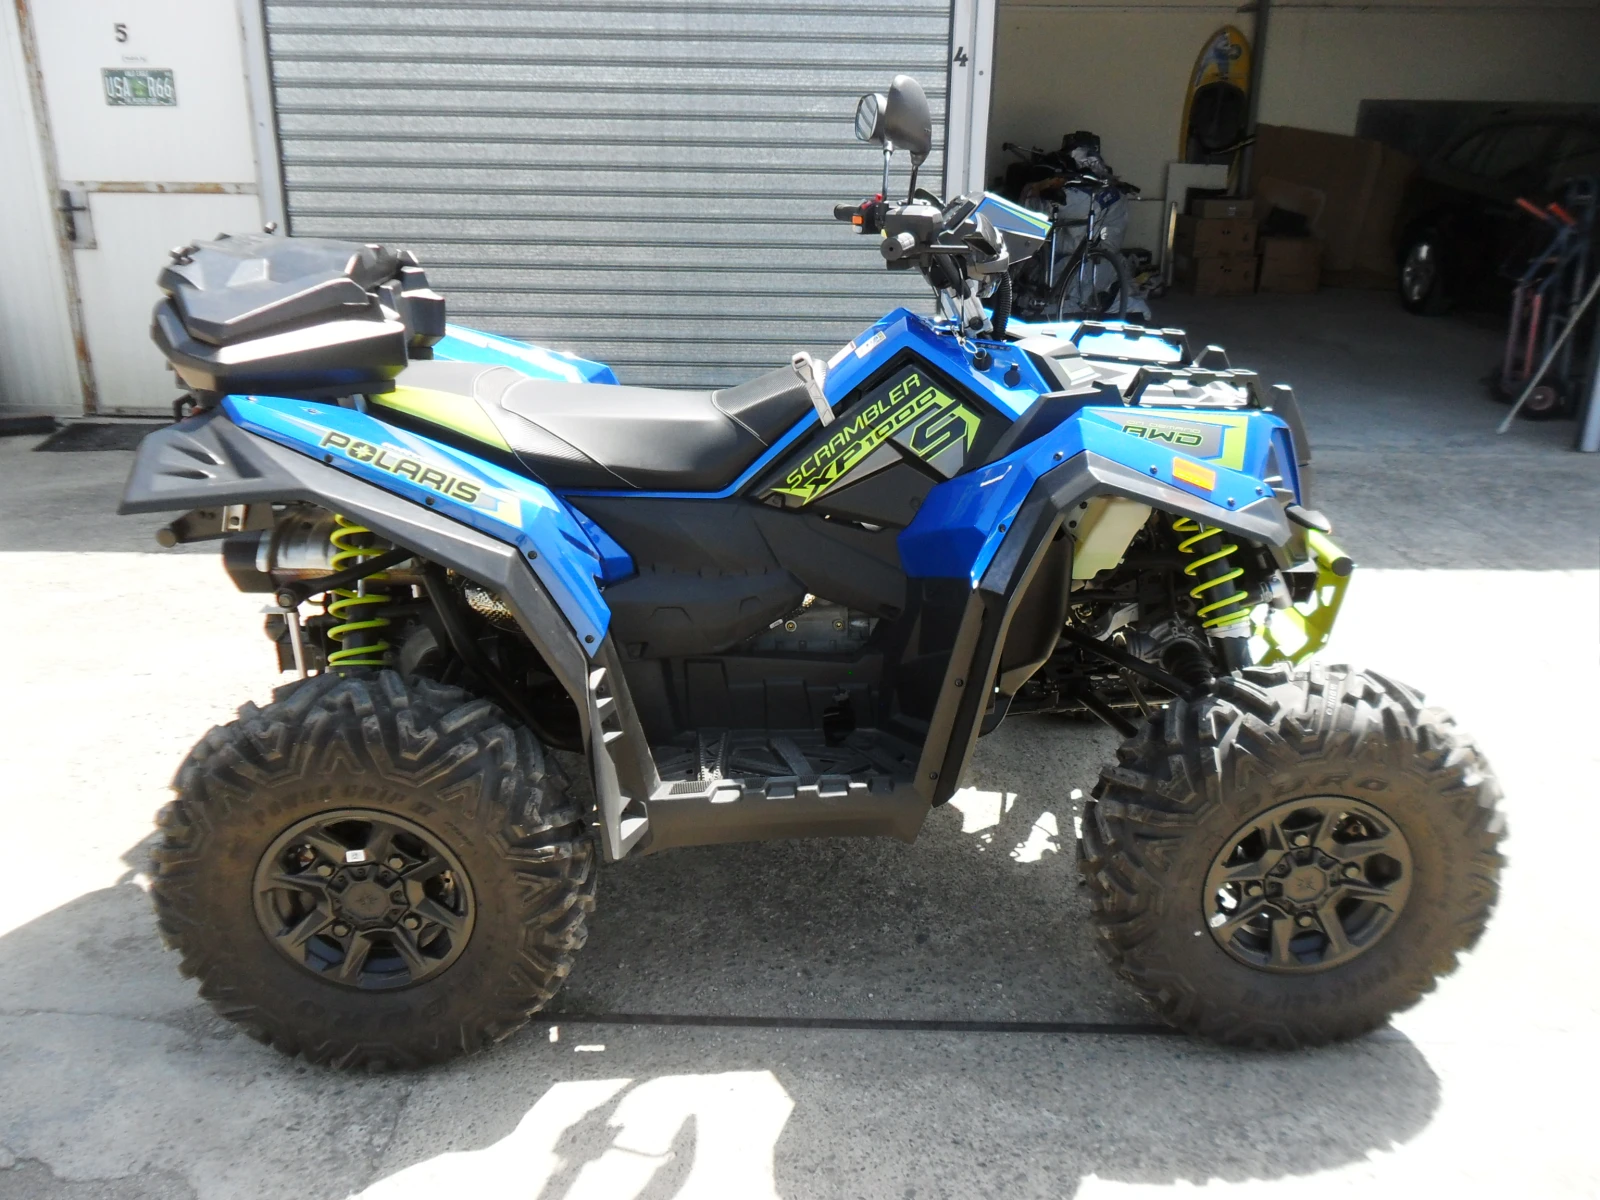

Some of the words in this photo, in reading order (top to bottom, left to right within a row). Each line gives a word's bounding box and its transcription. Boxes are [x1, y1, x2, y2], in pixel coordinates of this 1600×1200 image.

[114, 23, 128, 43] 5
[953, 46, 969, 67] 4
[104, 76, 131, 98] USA
[146, 76, 173, 98] R66
[786, 373, 921, 491] SCRAMBLER
[800, 387, 938, 501] XP1000
[320, 430, 482, 504] POLARIS
